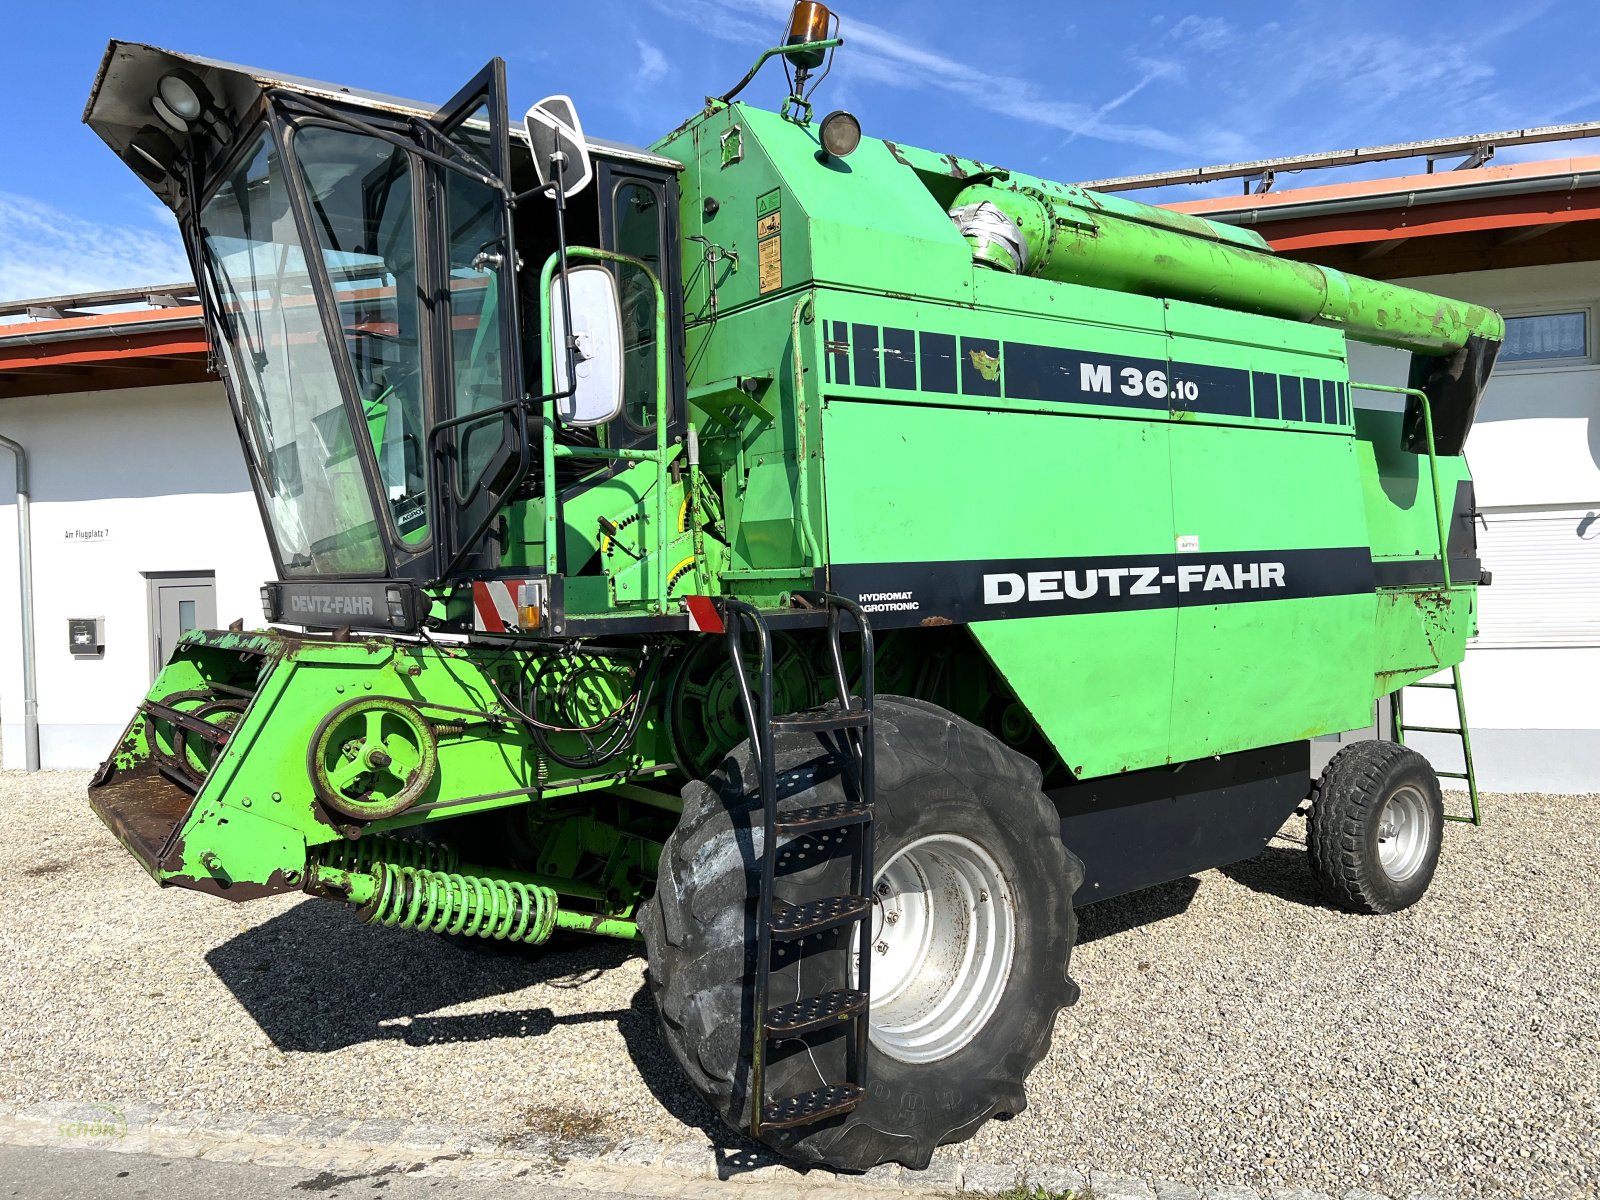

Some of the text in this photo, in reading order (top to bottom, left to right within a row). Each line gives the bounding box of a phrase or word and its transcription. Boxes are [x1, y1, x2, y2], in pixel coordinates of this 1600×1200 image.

[1080, 362, 1112, 393] M
[75, 530, 103, 539] Flugplatz
[983, 562, 1286, 605] DEUTZ-FAHR
[291, 595, 374, 615] DEUTZ-FAHR
[859, 591, 913, 602] HYDROMAT
